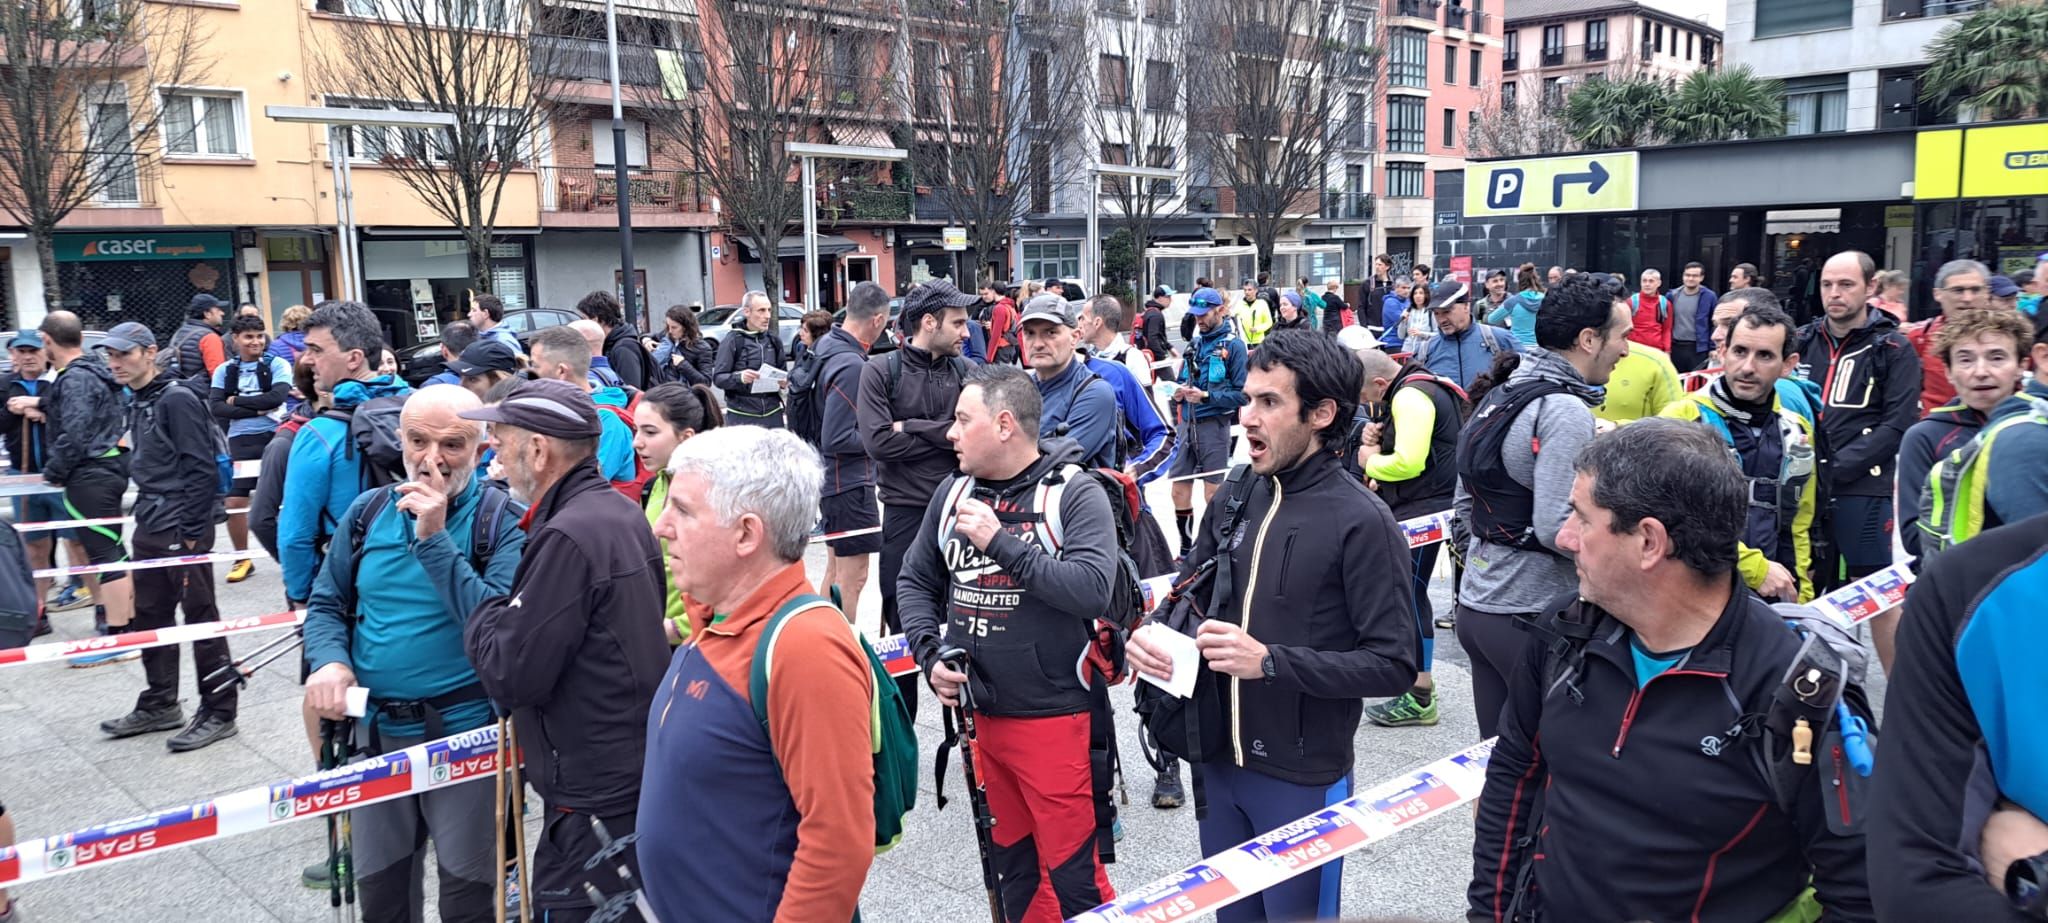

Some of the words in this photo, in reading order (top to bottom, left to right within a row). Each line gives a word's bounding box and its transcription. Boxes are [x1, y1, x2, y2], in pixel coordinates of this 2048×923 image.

[1494, 173, 1518, 204] P
[97, 239, 156, 255] caser
[977, 574, 1020, 587] SUPPL
[953, 588, 1020, 606] HANDCRAFTED
[968, 617, 989, 637] 75
[873, 638, 902, 655] TODO
[296, 785, 361, 812] SPAR
[78, 831, 156, 861] SPAR
[1280, 838, 1332, 867] SPAR
